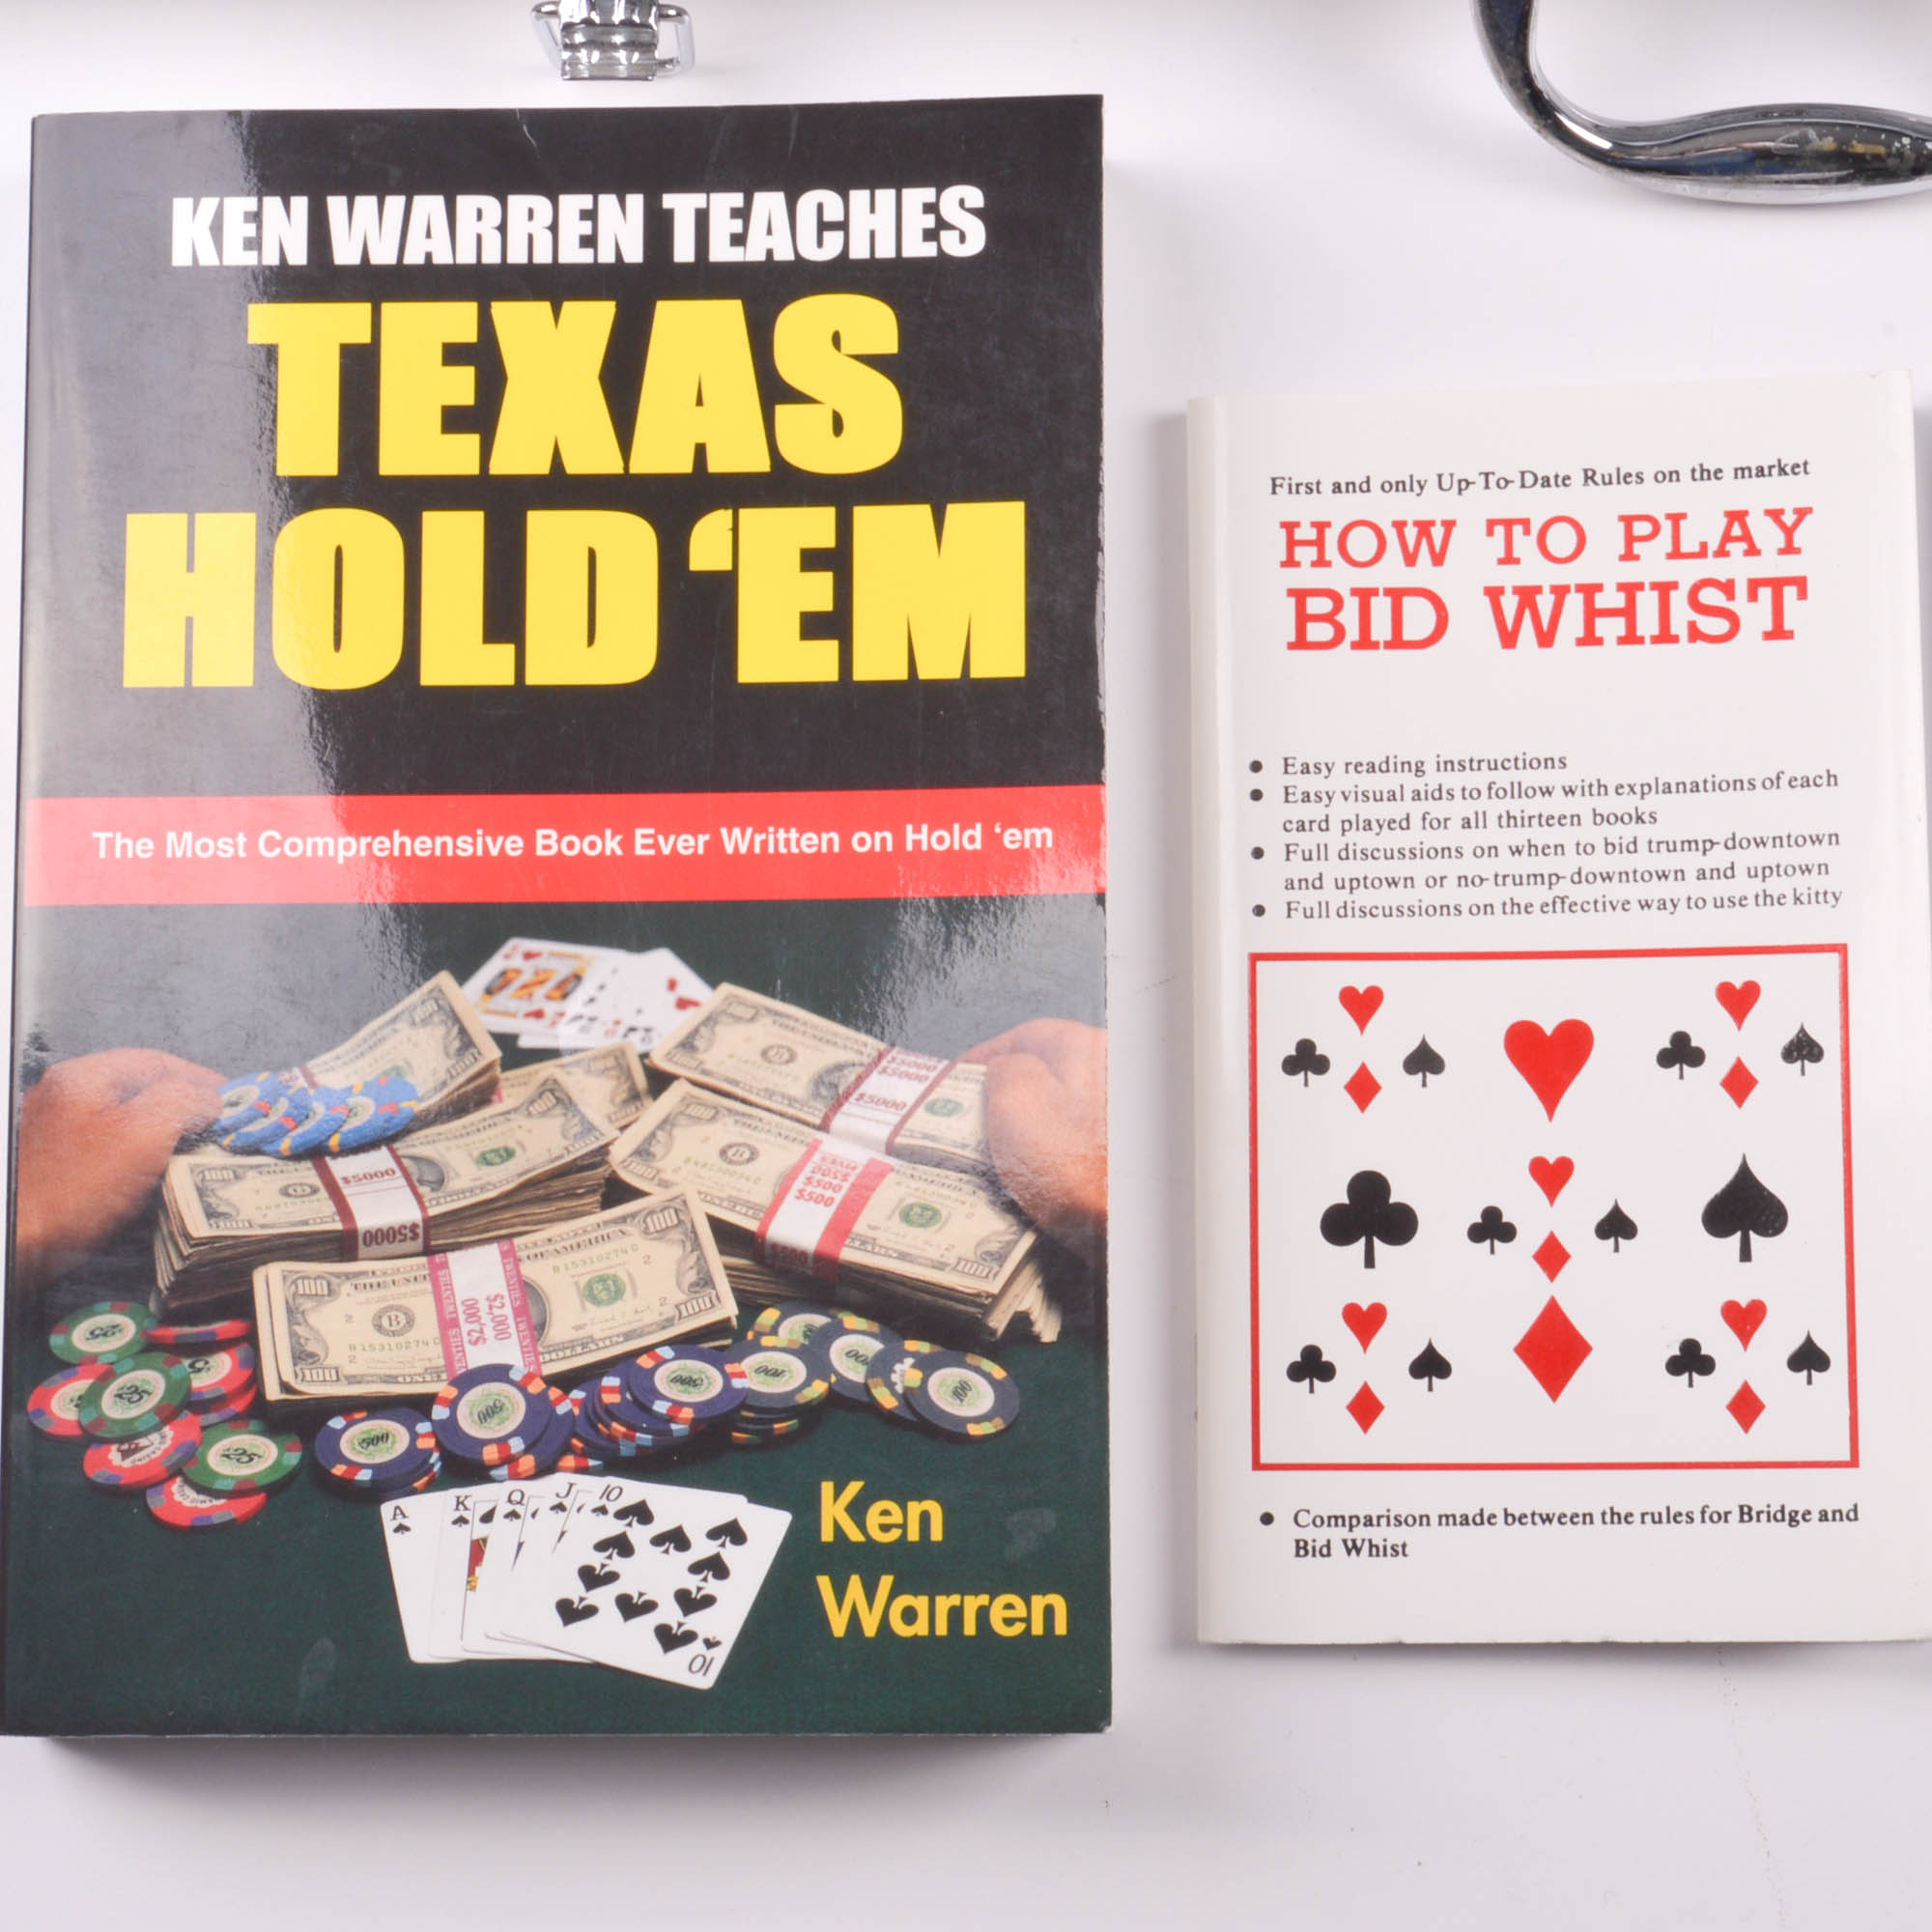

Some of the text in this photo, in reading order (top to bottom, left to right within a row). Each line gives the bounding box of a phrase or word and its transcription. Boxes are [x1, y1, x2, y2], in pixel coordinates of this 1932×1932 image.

[172, 185, 985, 266] KEN WARREN TEACHES
[247, 292, 904, 477] TEXAS
[1271, 477, 1321, 495] First
[1332, 475, 1371, 494] and
[1380, 474, 1427, 497] only
[1583, 468, 1644, 486] Rules
[1654, 470, 1680, 483] on
[1690, 464, 1723, 481] the
[1734, 459, 1809, 479] market
[1280, 507, 1813, 568] HOW TO PLAY
[124, 507, 660, 691] HOLD
[1287, 576, 1808, 651] BID WHIST
[1283, 753, 1567, 779] Easy reading instructions
[1285, 769, 1837, 807] Easy visual aids to follow with explanations of each
[1283, 807, 1657, 836] card played for all thirteen books
[91, 832, 155, 859] The
[166, 831, 247, 858] Most
[258, 829, 523, 865] Comprehensive
[537, 830, 622, 855] Book
[636, 829, 709, 855] Ever
[721, 827, 838, 853] Written
[852, 832, 892, 852] on
[907, 823, 981, 850] Hold
[1286, 843, 1327, 861] Full
[1338, 843, 1463, 861] discussions
[1473, 846, 1498, 858] on
[1509, 839, 1564, 856] when
[1576, 842, 1595, 855] to
[1605, 837, 1637, 854] bid
[1285, 873, 1322, 890] and
[1335, 876, 1414, 894] uptown
[1426, 876, 1447, 888] or
[1697, 862, 1735, 880] and
[1747, 864, 1829, 882] uptown
[1287, 887, 1842, 919] Full discussions on the effective way to use the kitty
[341, 1167, 397, 1186] $5000
[795, 1188, 836, 1208] $500
[362, 1223, 420, 1248] $5000
[461, 1297, 487, 1346] $2,000
[486, 1293, 512, 1341] $2,000
[453, 1494, 472, 1512] K
[506, 1488, 526, 1507] Q
[555, 1482, 574, 1499] J
[599, 1484, 624, 1502] 10
[389, 1505, 410, 1520] A
[821, 1481, 943, 1543] Ken
[1293, 1503, 1859, 1532] Comparison made between the rules for Bridge and
[1294, 1539, 1407, 1557] Bid Whist
[816, 1574, 1067, 1637] Warren
[687, 1653, 716, 1678] 10
